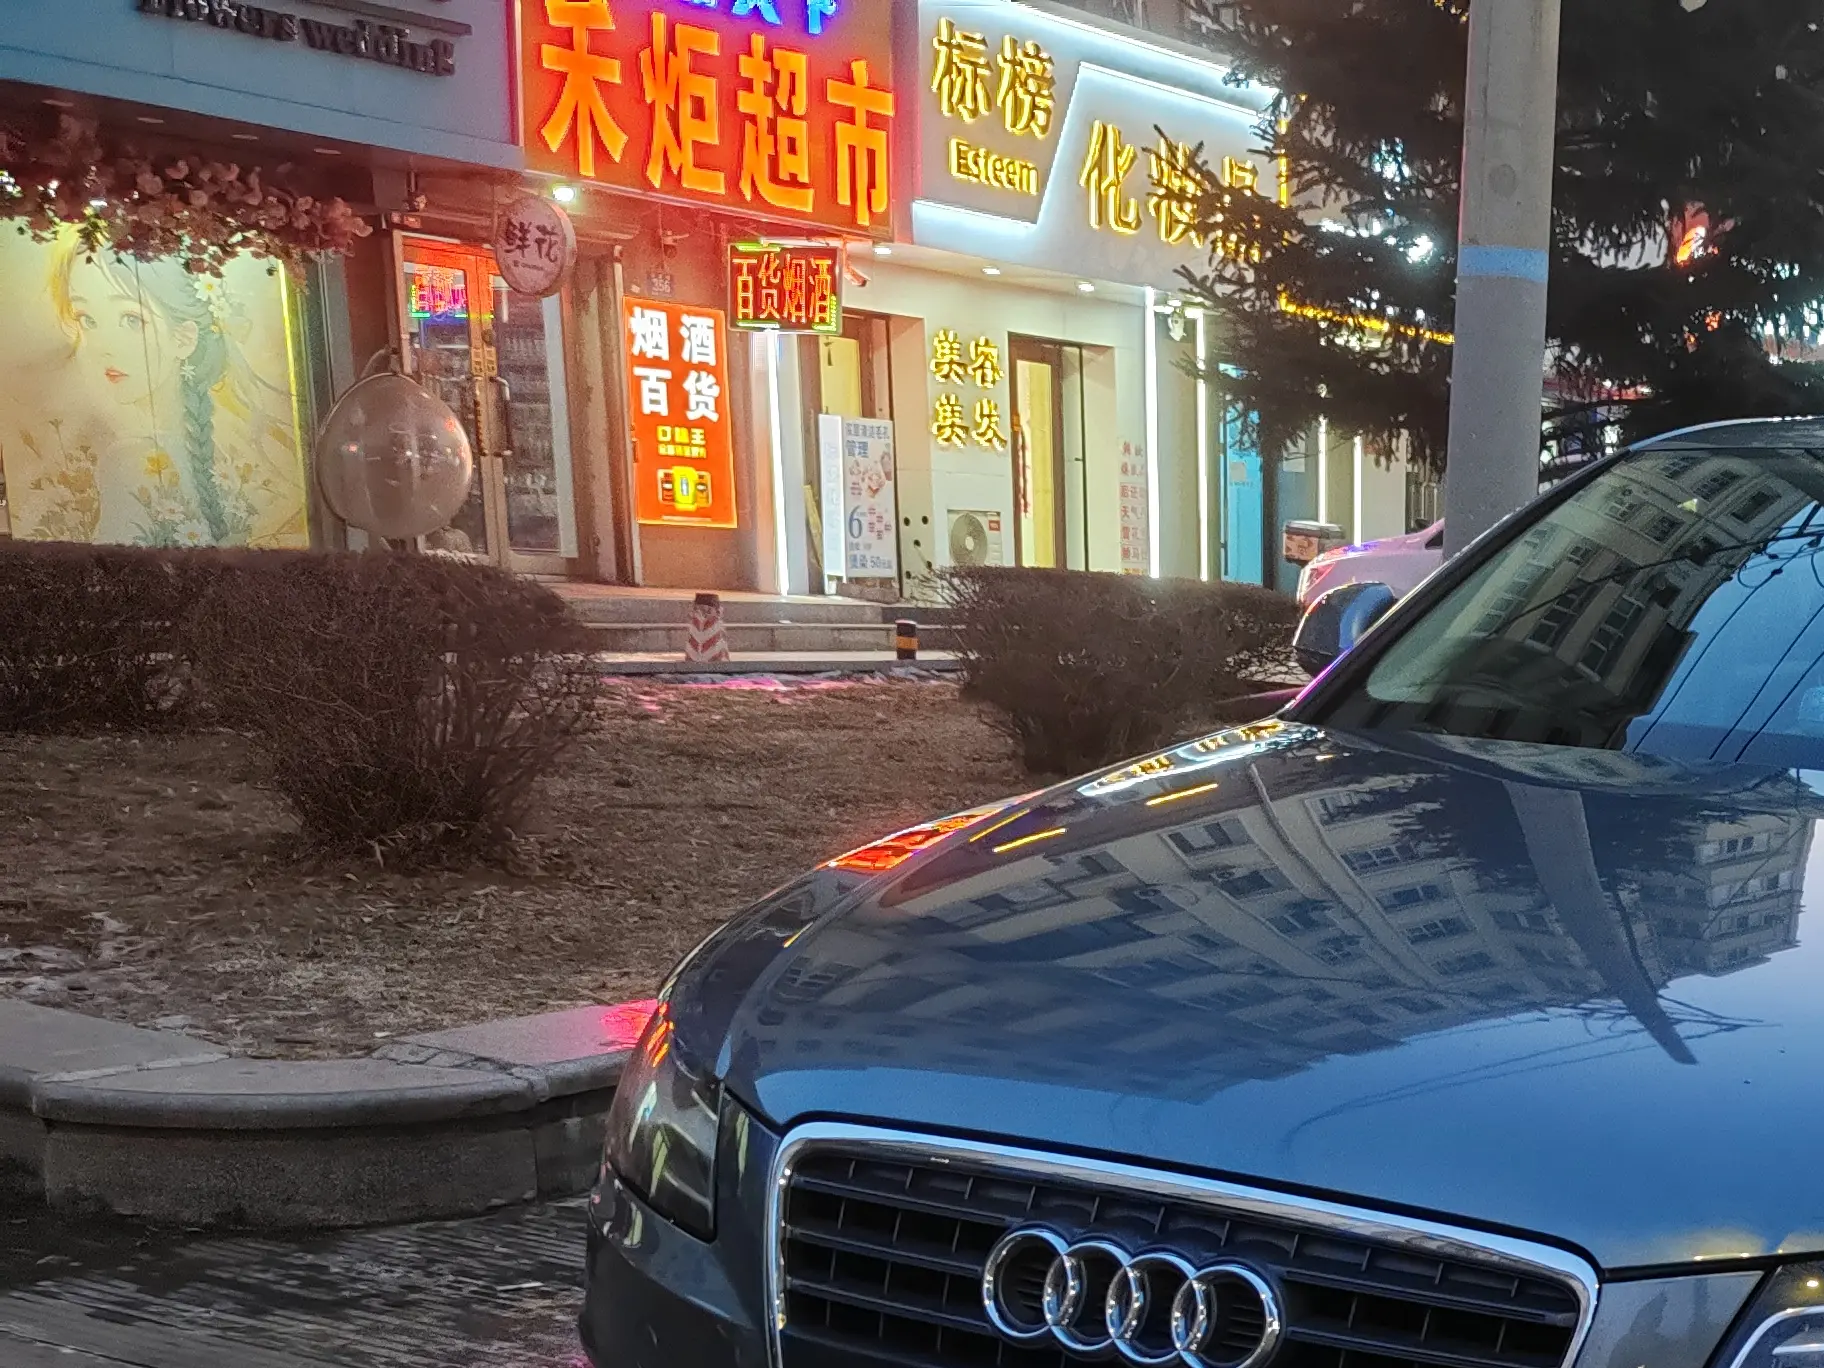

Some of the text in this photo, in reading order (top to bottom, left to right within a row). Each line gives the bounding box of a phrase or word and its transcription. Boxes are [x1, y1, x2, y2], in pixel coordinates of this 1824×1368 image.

[300, 18, 455, 76] wedding
[931, 16, 1057, 140] 标榜
[948, 137, 1039, 195] Esteem
[504, 219, 560, 263] 鲜花
[732, 252, 832, 323] 百货烟酒
[629, 306, 717, 366] 烟酒
[930, 330, 1004, 389] 美容
[633, 366, 720, 422] 百货
[848, 505, 863, 539] 6
